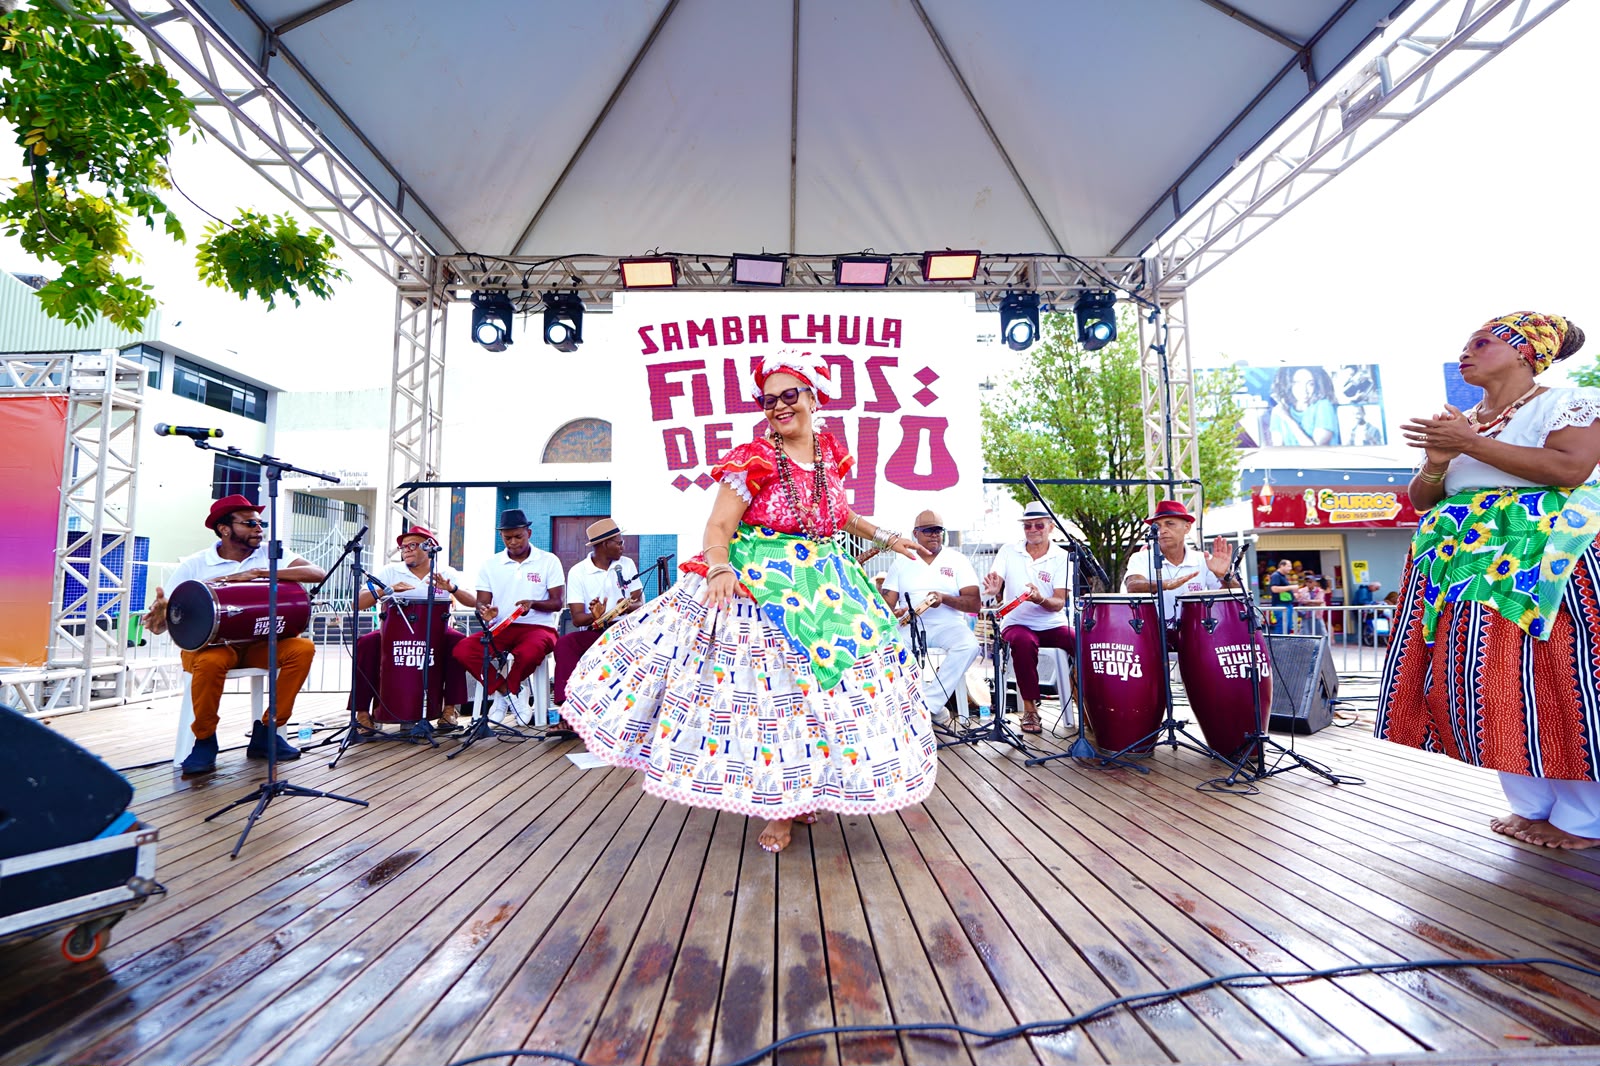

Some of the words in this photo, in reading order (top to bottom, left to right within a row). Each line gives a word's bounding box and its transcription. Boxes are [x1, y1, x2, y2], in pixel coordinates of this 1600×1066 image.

[637, 314, 769, 355] SAMBA
[781, 313, 902, 349] CHULA
[646, 354, 902, 421] FILOS
[662, 421, 736, 471] DE
[1321, 493, 1396, 510] CHURROS
[394, 655, 405, 663] DE
[1090, 650, 1134, 664] FILHOS
[1092, 661, 1105, 670] DE
[1222, 665, 1239, 676] DE
